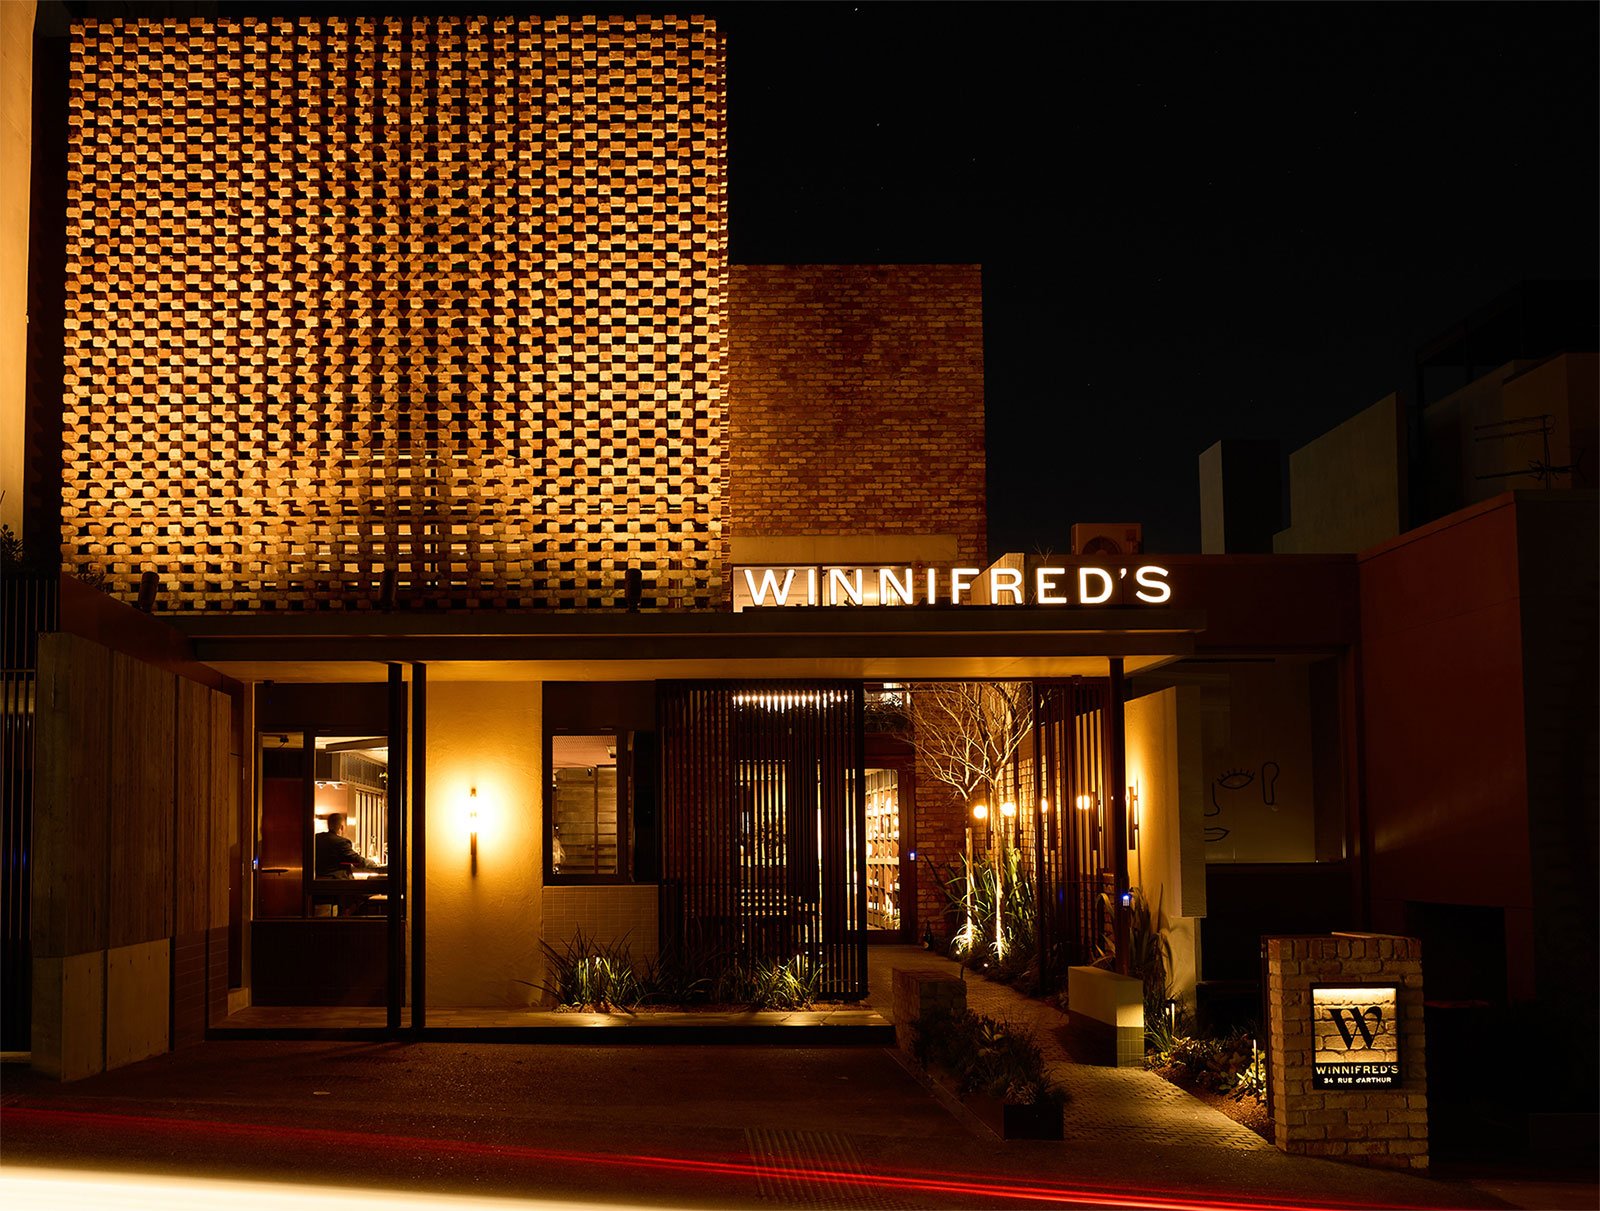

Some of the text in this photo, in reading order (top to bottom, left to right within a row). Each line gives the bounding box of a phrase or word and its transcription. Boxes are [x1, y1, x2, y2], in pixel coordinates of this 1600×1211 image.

[743, 565, 1172, 606] WINNIFRED'S
[1324, 1005, 1382, 1050] W
[1315, 1065, 1399, 1075] WINNIFRED'S
